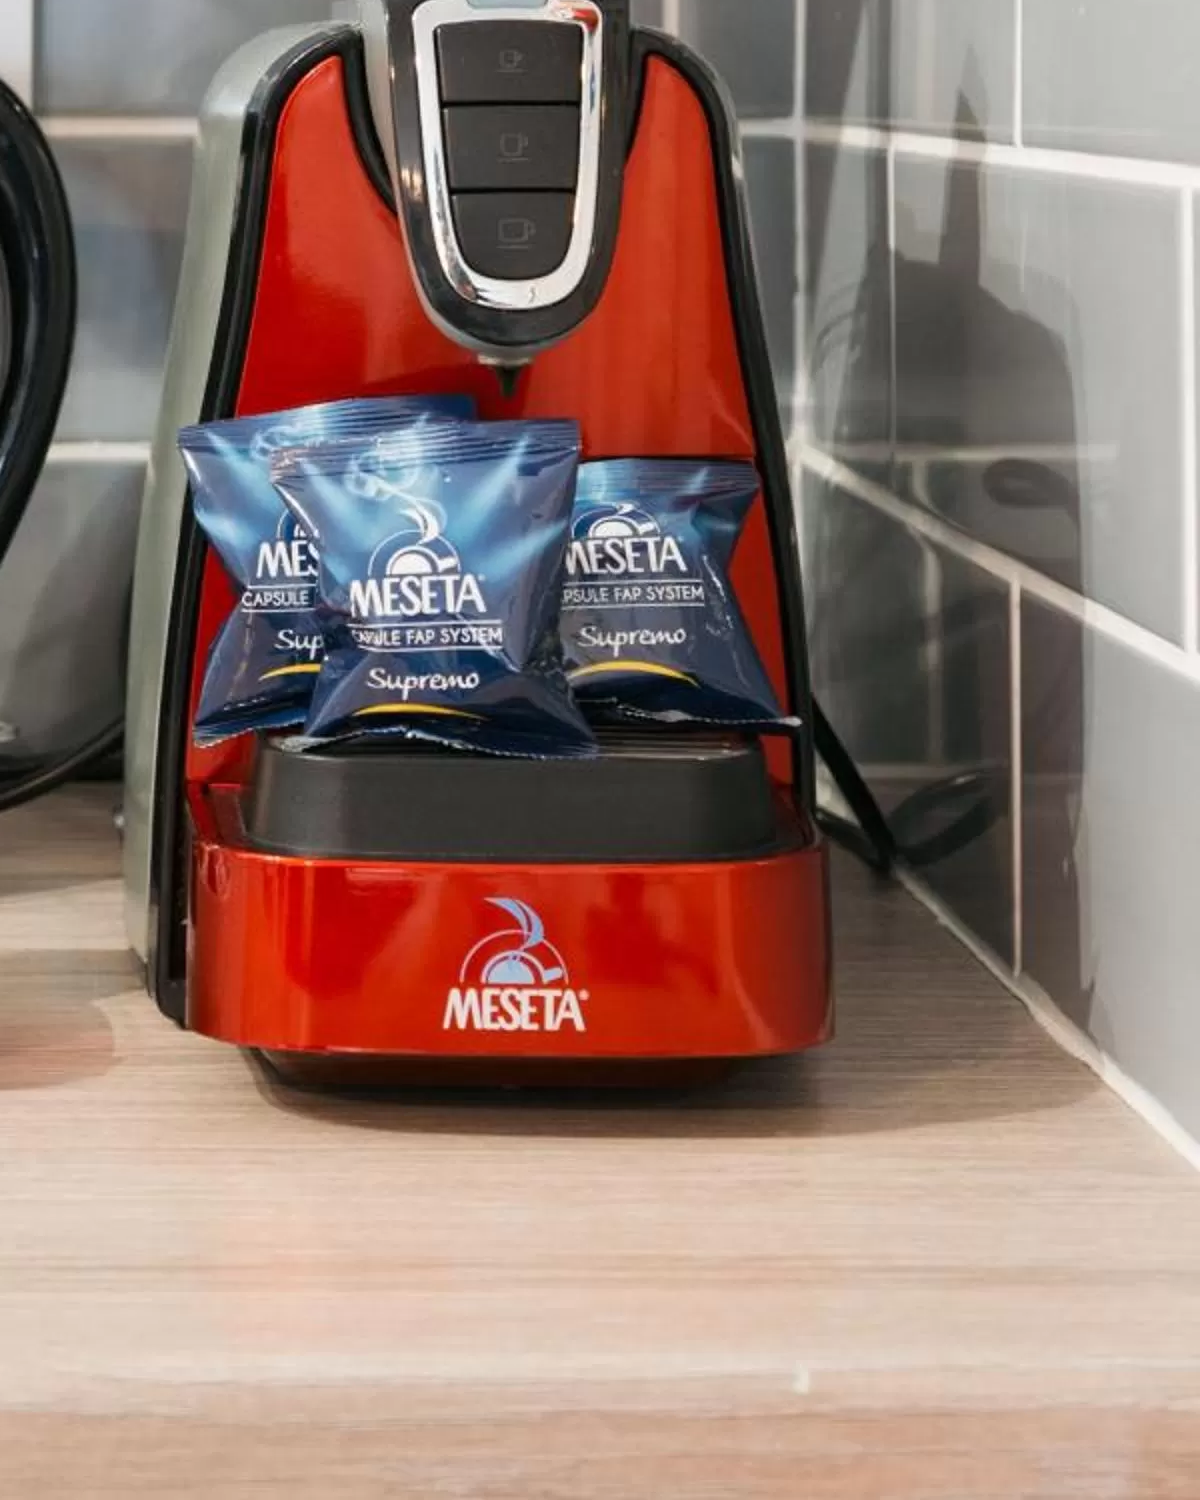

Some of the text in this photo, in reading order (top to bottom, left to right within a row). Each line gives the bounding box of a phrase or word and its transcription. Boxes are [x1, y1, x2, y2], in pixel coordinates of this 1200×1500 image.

[241, 590, 310, 607] CAPSULE
[350, 573, 488, 619] MESETA
[614, 586, 642, 601] FAP
[646, 585, 705, 601] SYSTEM
[406, 628, 436, 646] FAP
[440, 627, 503, 644] SYSTEM
[577, 625, 687, 658] Supremo
[367, 668, 481, 701] Supremo
[442, 986, 587, 1032] MESETA
